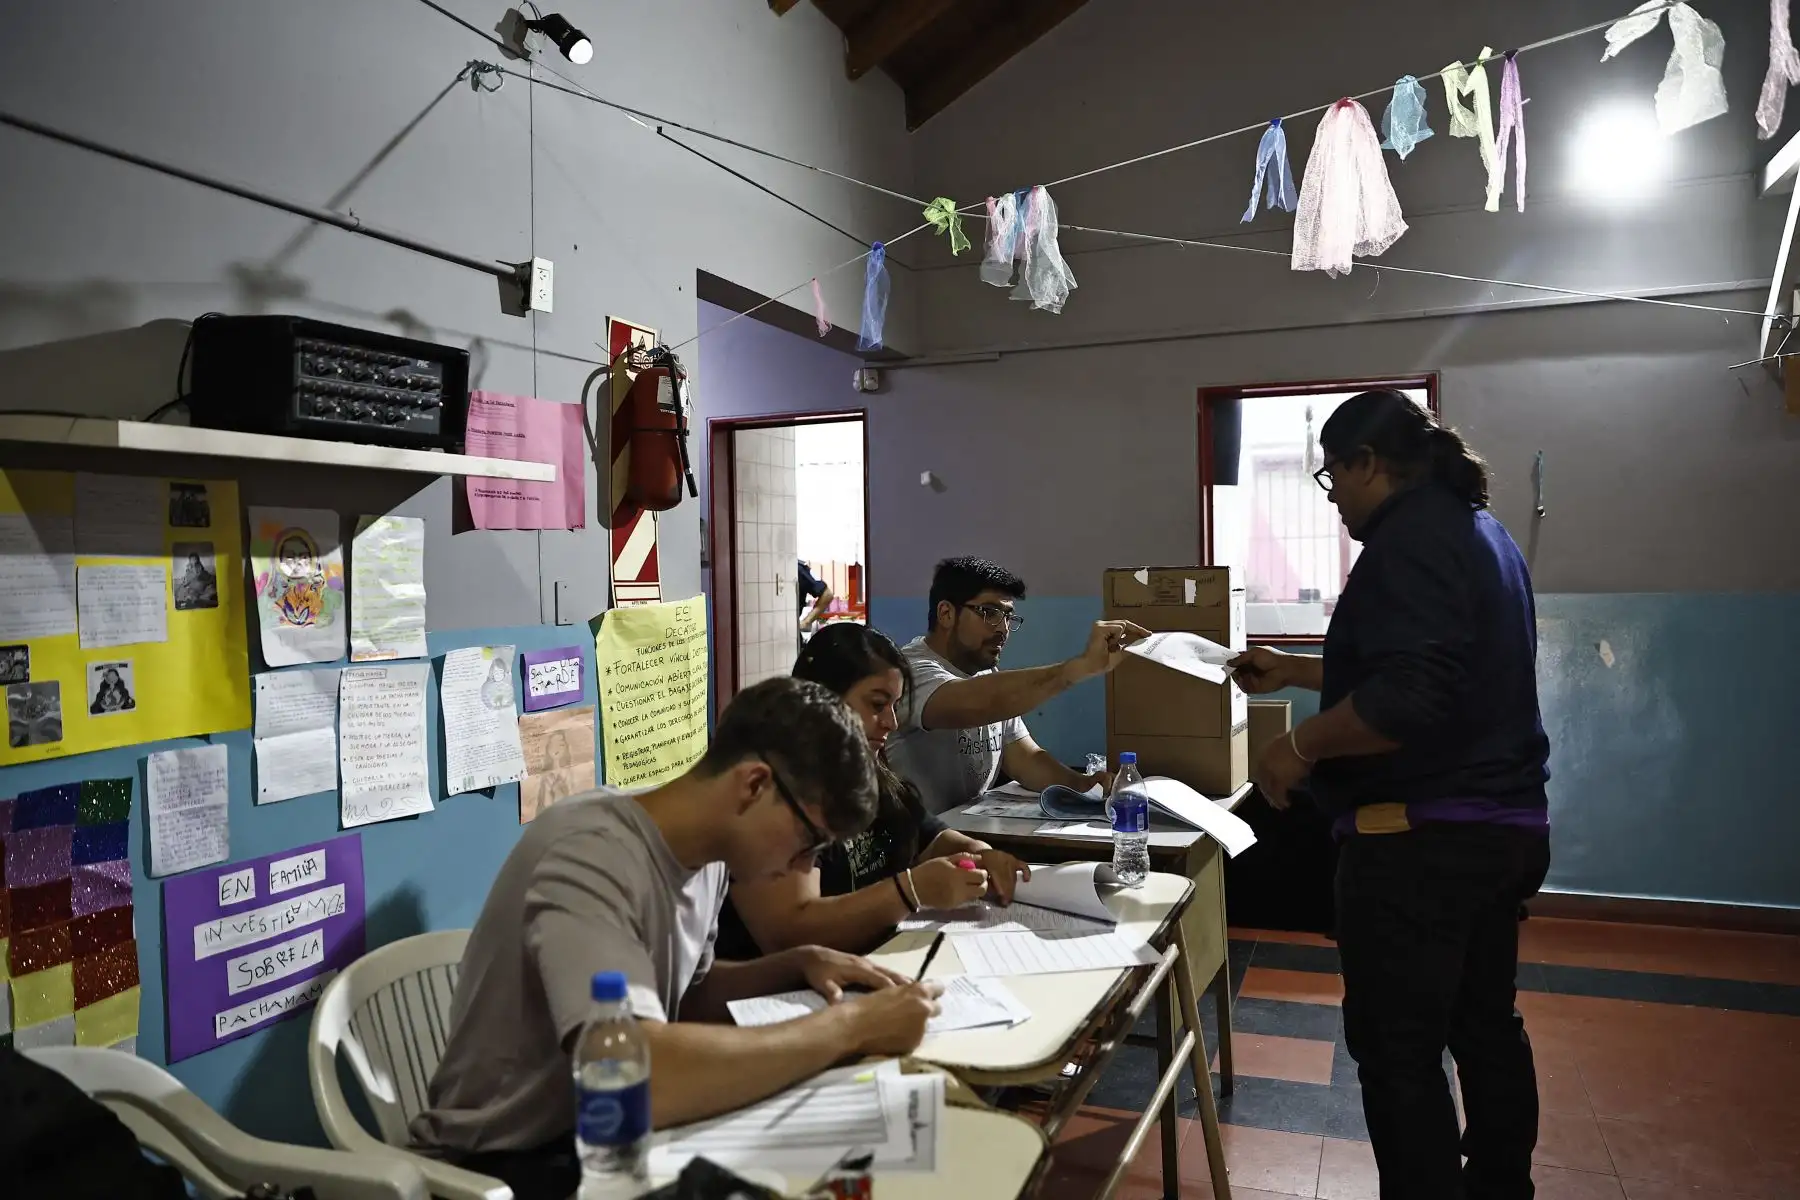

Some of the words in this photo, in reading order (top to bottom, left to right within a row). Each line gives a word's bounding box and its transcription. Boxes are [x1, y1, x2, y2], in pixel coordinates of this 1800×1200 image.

[613, 656, 665, 676] FORTALECER
[616, 693, 656, 712] CUESTIONAR
[221, 876, 251, 901] EN
[236, 946, 297, 988] SOBRE
[301, 938, 320, 960] LA
[218, 983, 323, 1033] PACHAMAM
